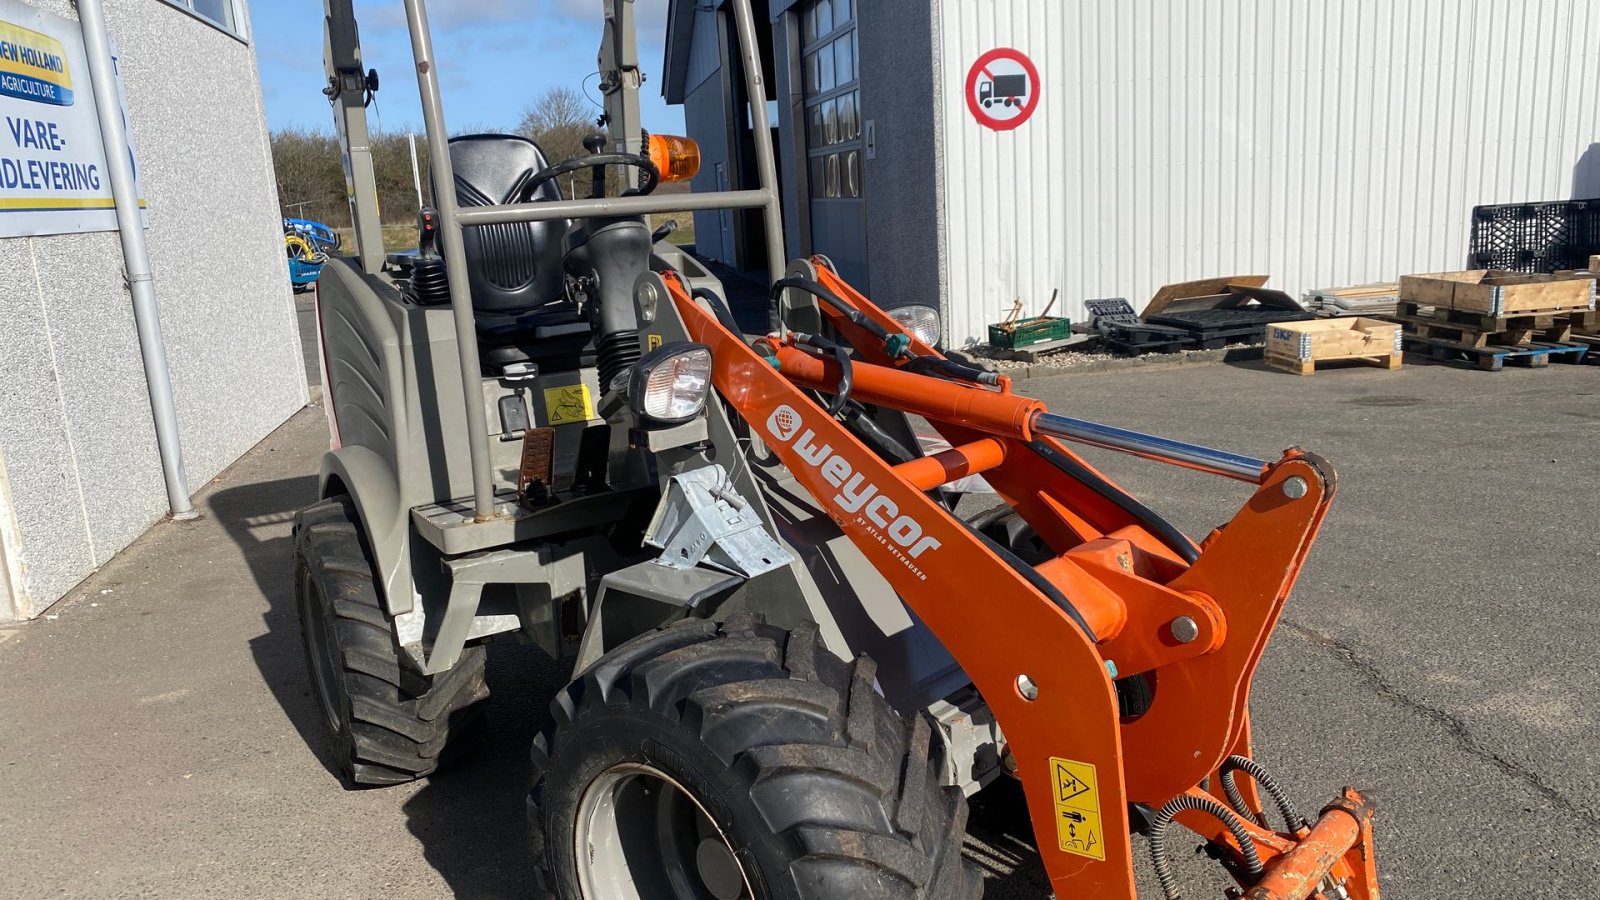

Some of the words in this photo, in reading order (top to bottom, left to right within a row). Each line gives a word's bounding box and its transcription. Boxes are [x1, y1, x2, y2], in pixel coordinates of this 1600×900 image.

[19, 45, 63, 73] HOLLAND
[1, 74, 56, 99] AGRICULTURE
[6, 116, 66, 151] VARE-
[1274, 329, 1293, 340] SKF
[856, 517, 867, 526] BY
[866, 526, 887, 545] ATLAS
[887, 543, 927, 581] WEYHAUSEN
